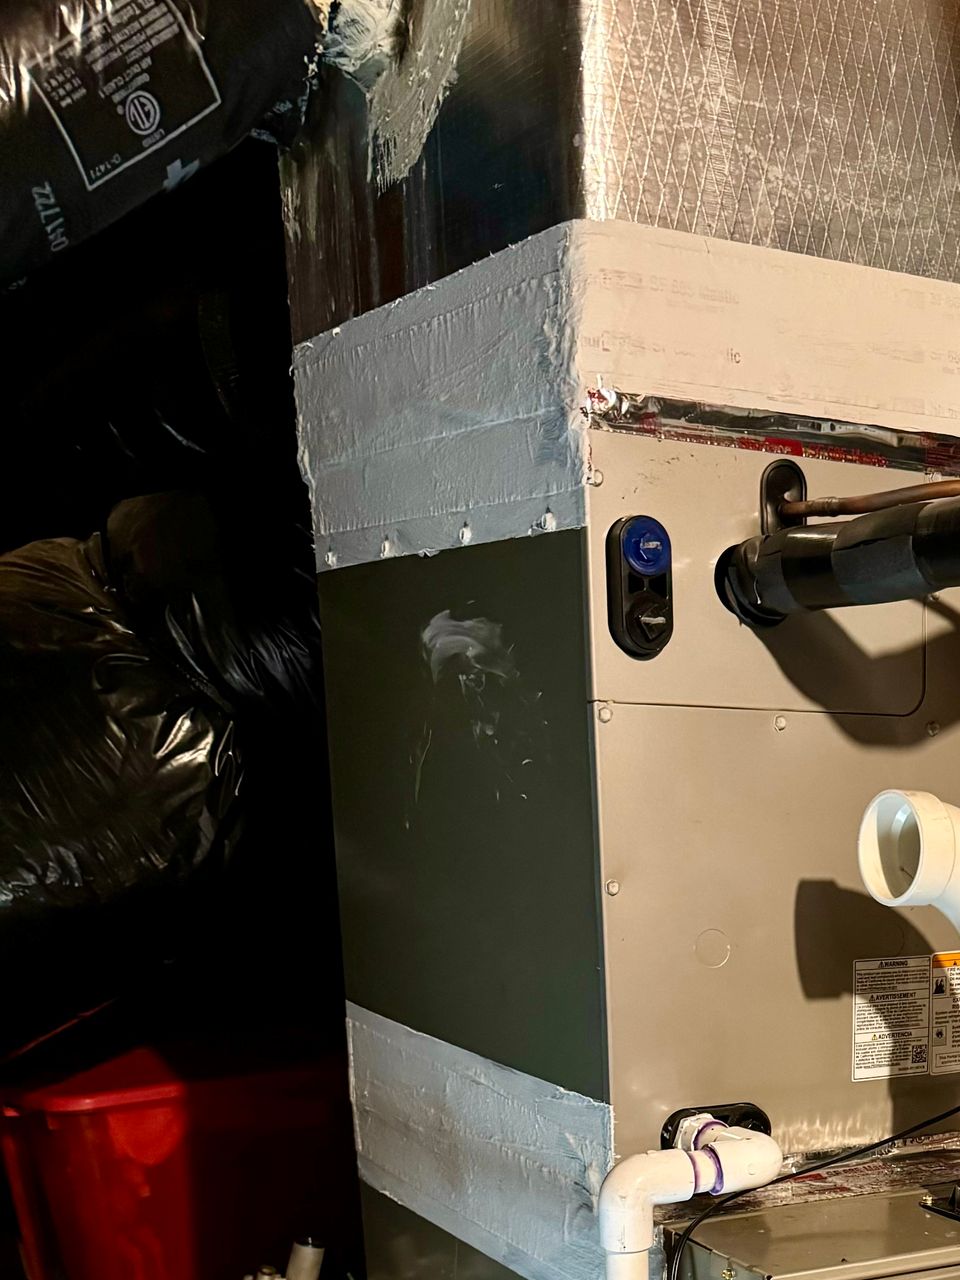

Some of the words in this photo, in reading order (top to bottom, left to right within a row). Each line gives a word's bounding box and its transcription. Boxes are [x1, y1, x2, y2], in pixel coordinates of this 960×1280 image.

[884, 960, 909, 968] WARNING
[875, 992, 917, 1001] AVERTISSEMENT
[878, 1032, 912, 1040] ADVERTENCIA
